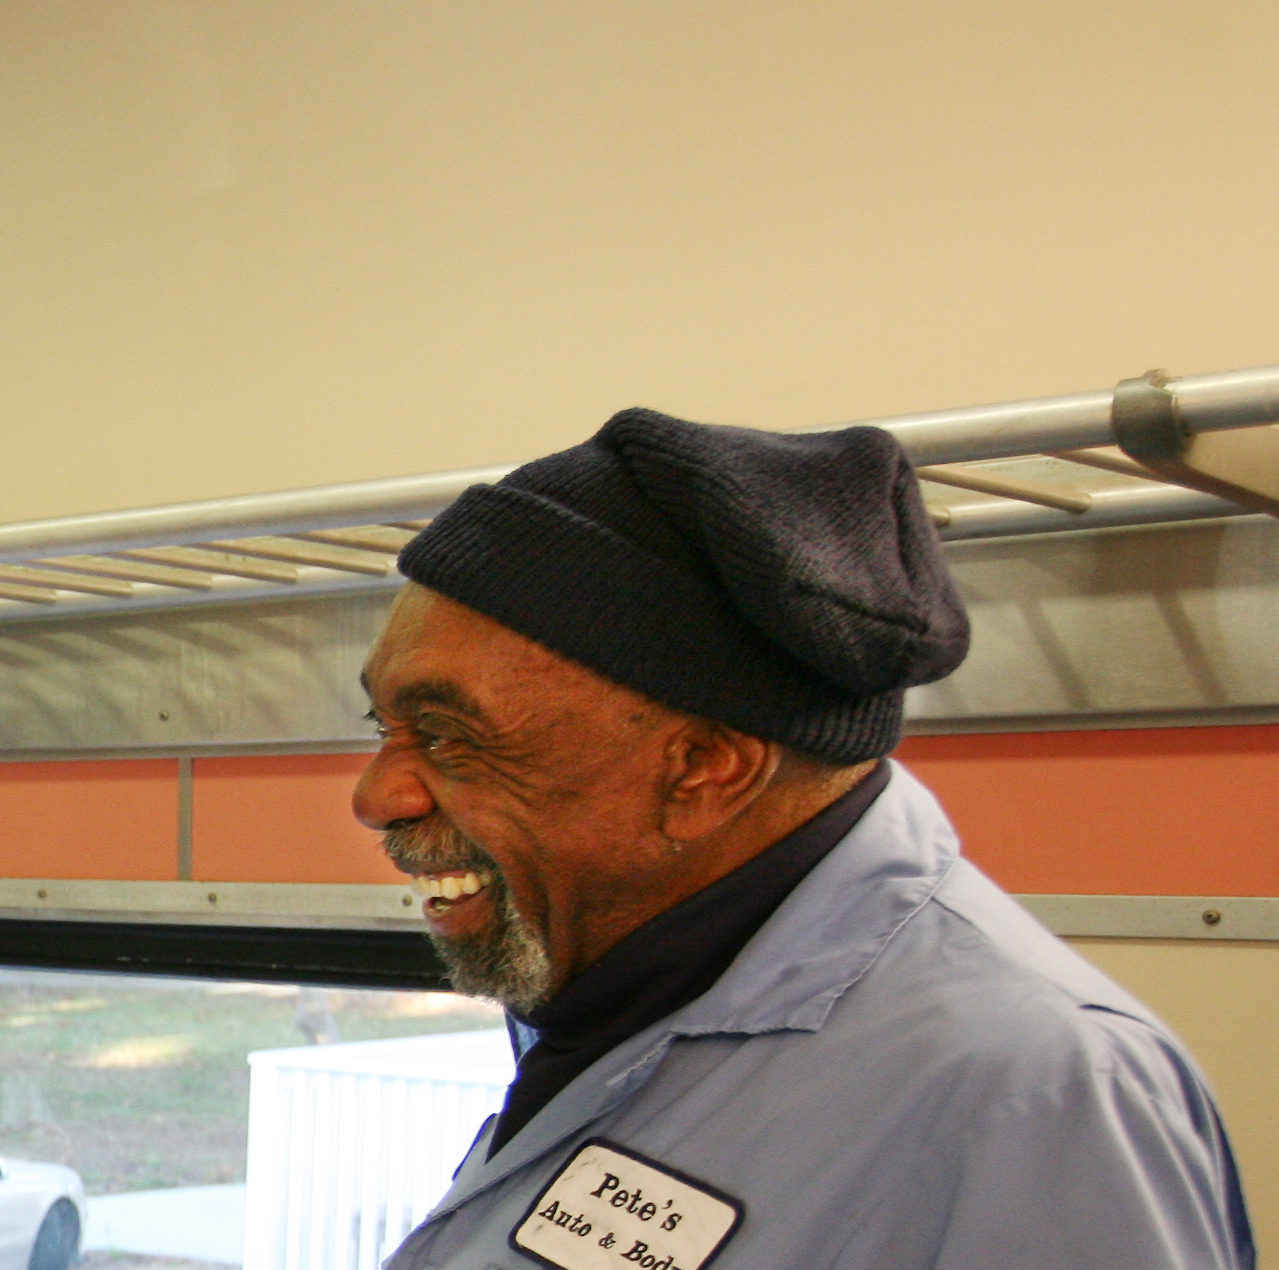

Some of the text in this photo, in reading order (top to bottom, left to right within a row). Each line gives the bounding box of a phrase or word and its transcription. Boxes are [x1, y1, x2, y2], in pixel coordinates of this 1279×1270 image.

[538, 1200, 592, 1237] Auto
[598, 1232, 617, 1249] &
[590, 1173, 682, 1231] Pete's
